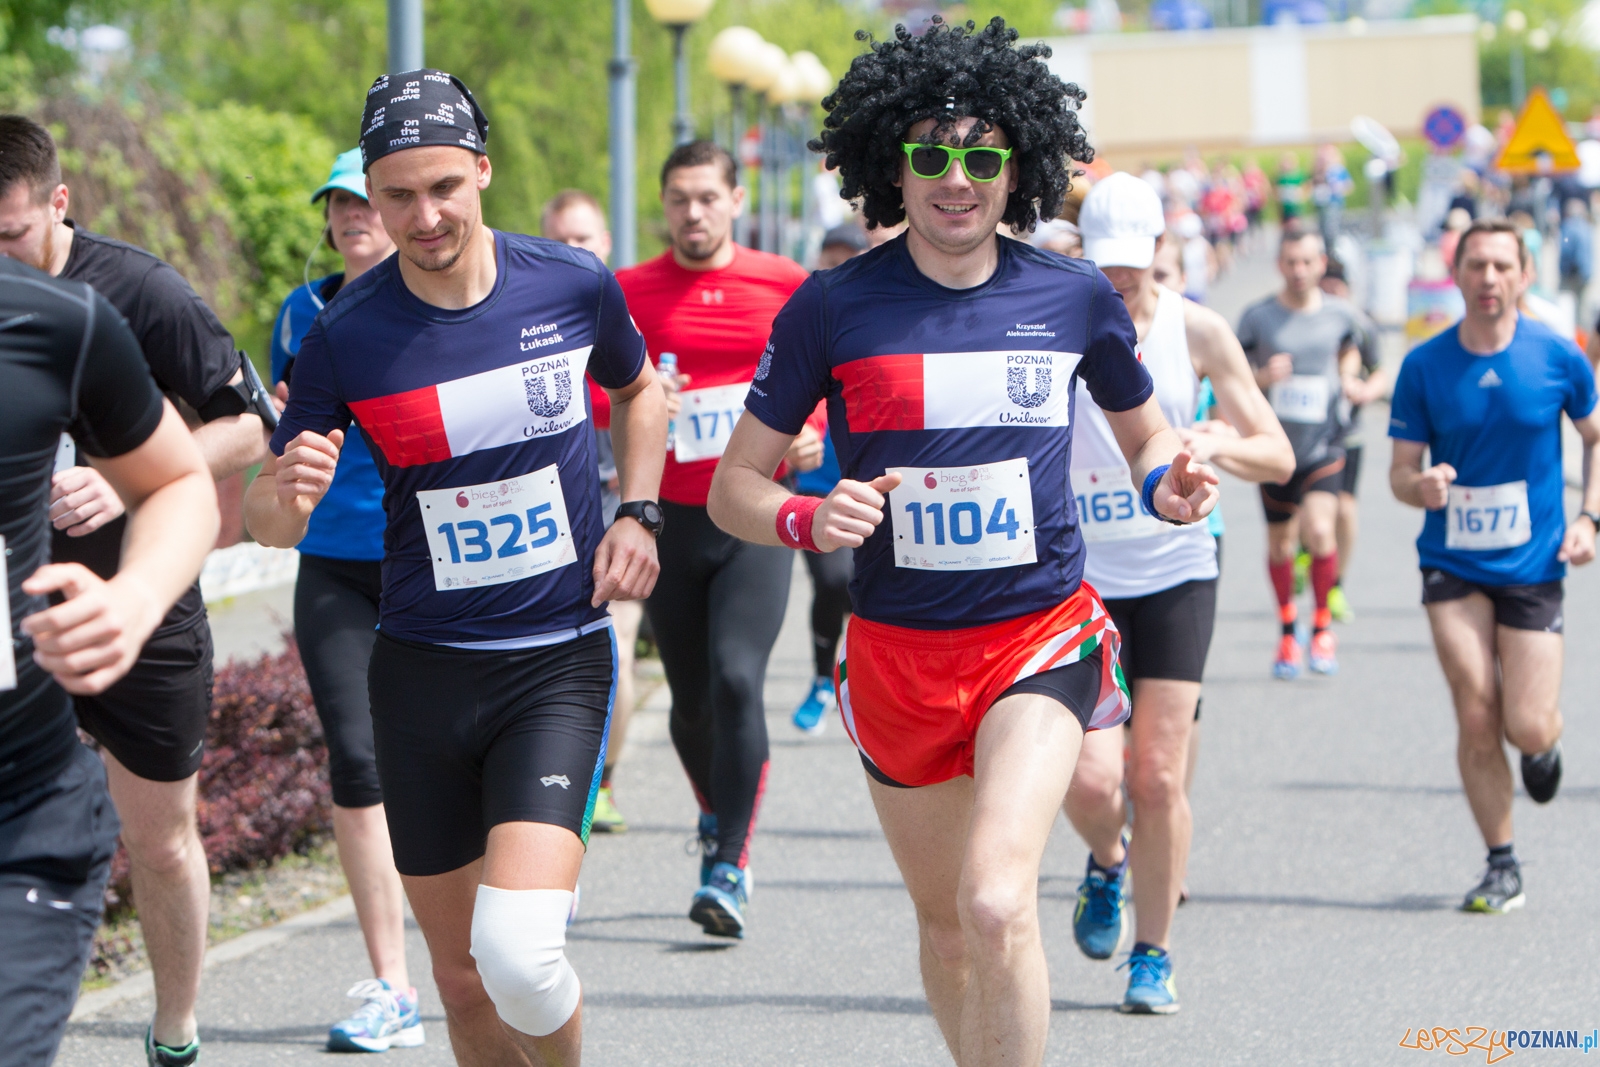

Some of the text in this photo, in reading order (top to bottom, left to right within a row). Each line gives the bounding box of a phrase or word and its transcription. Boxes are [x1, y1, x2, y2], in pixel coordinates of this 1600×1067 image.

[424, 74, 450, 85] move
[402, 87, 421, 95] the
[390, 93, 421, 104] move
[374, 106, 386, 116] on
[440, 102, 454, 112] on
[371, 114, 385, 125] the
[424, 113, 455, 126] move
[437, 108, 455, 120] the
[403, 119, 420, 127] on
[400, 126, 420, 136] the
[466, 131, 476, 142] the
[389, 136, 420, 147] move
[521, 323, 558, 339] Adrian
[1016, 323, 1046, 331] Krzysztof
[520, 333, 564, 352] Łukasik
[1006, 354, 1053, 365] POZNAŃ
[521, 355, 570, 377] POZNAŃ
[999, 411, 1051, 423] Unilever
[523, 417, 574, 438] Unilever
[689, 408, 744, 440] 171
[940, 470, 968, 487] bieg
[905, 497, 1020, 546] 1104
[1455, 506, 1518, 533] 1677
[437, 501, 558, 565] 1325
